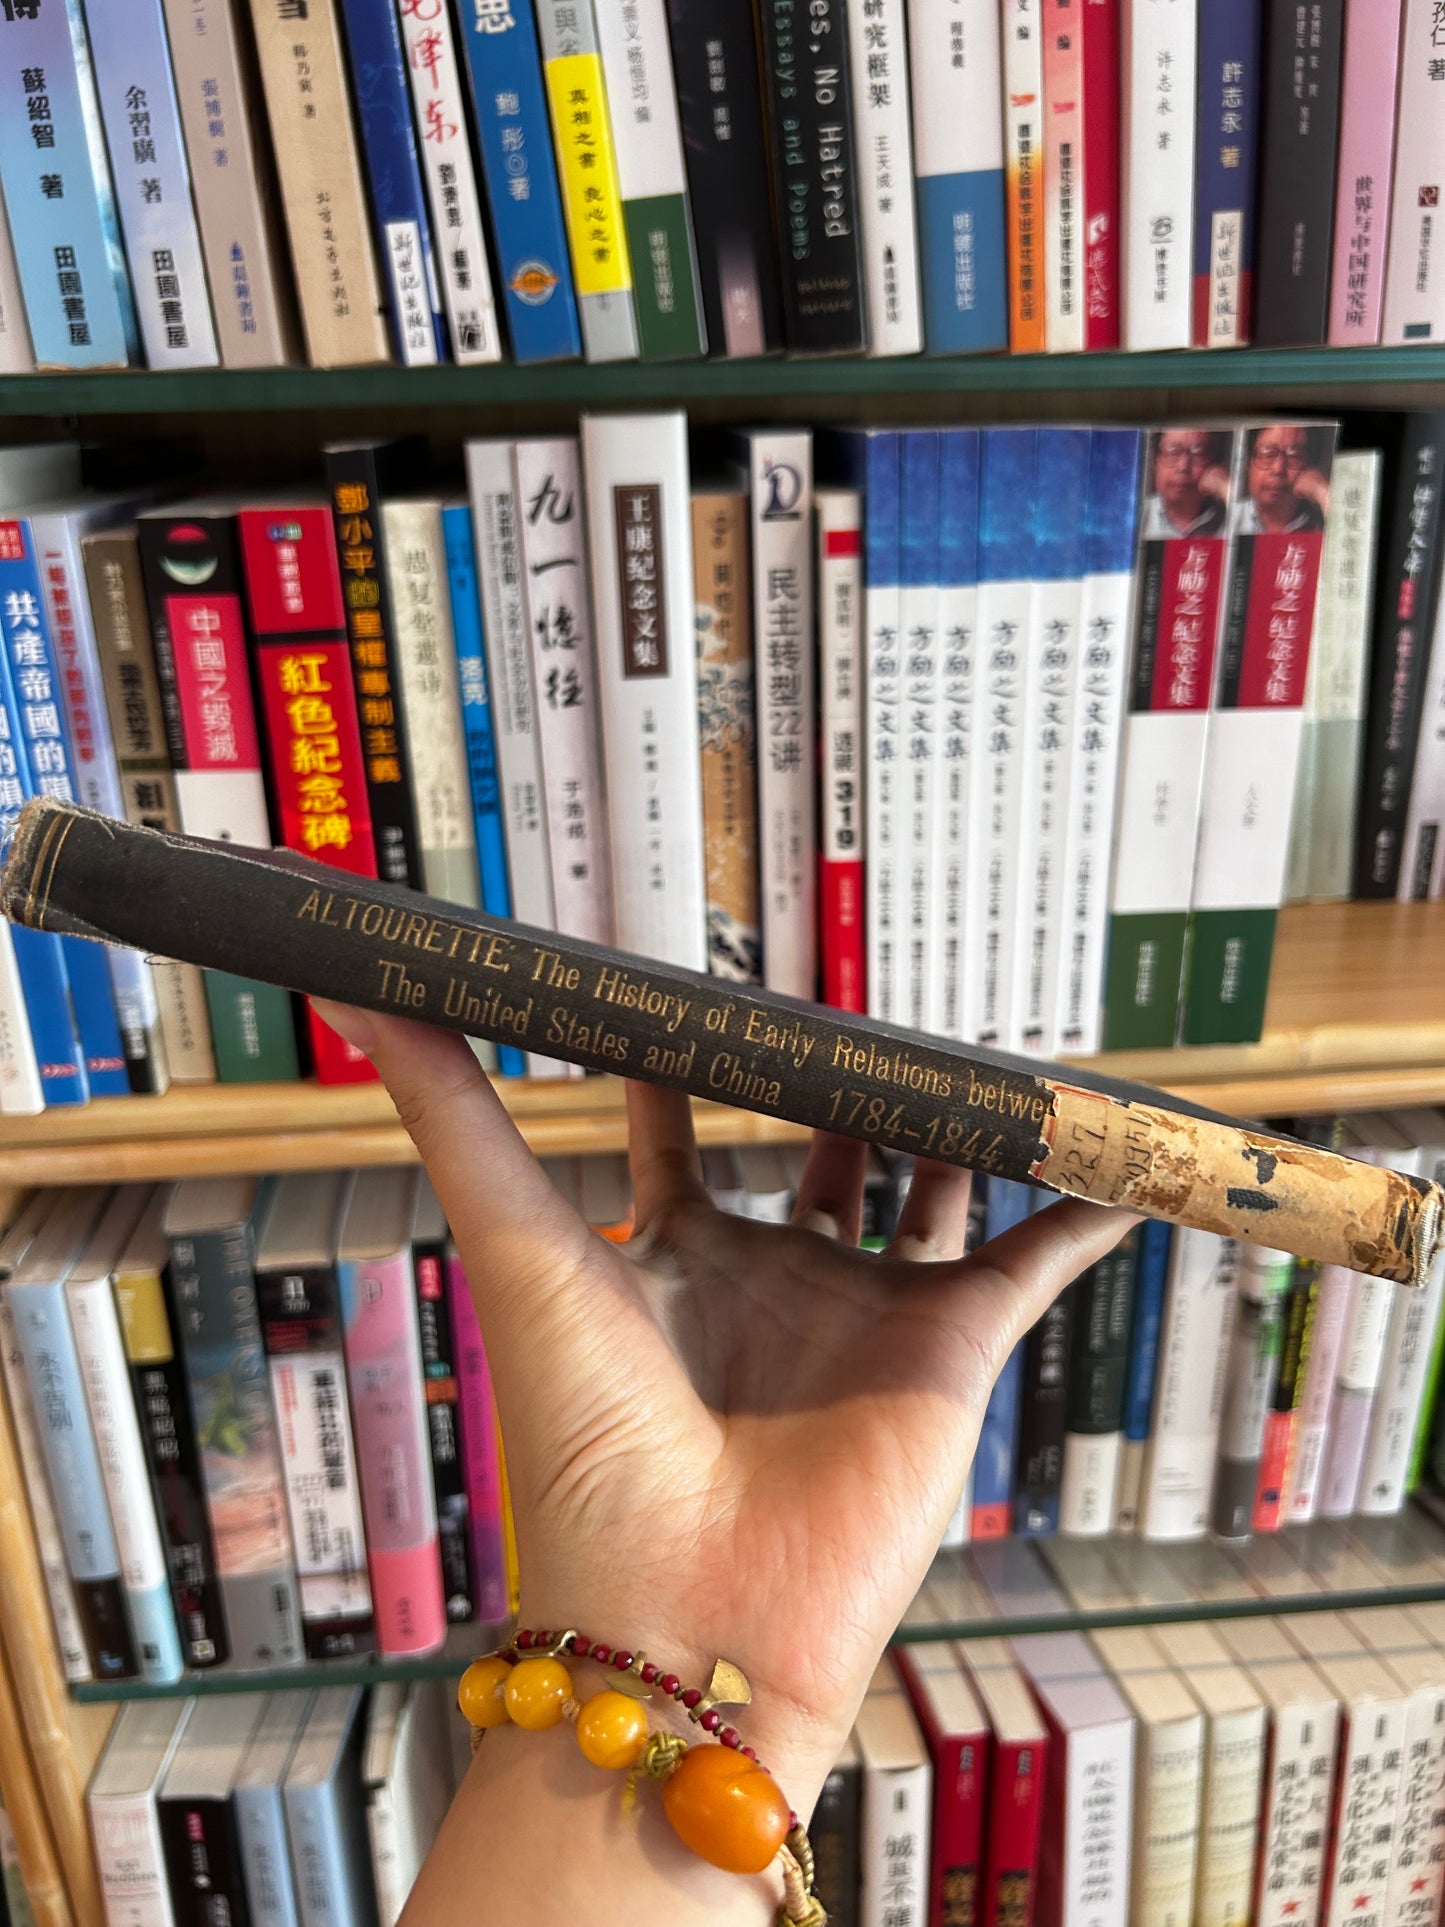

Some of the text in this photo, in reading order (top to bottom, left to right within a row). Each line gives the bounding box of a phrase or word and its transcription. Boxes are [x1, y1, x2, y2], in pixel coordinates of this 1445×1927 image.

[774, 0, 797, 98] Essays
[813, 66, 840, 105] No
[22, 67, 65, 200] 蘇紹智 著
[125, 85, 163, 204] 余習廣 著
[783, 118, 807, 165] and
[1220, 61, 1244, 168] 許志永 著
[817, 126, 852, 238] Hatred
[54, 246, 92, 347] 田園書屋
[152, 249, 189, 349] 田園書屋
[1345, 175, 1373, 328] 世界与中国研究所
[278, 653, 353, 850] 紅色紀念碑
[377, 959, 428, 1009] The
[443, 977, 534, 1036] United
[545, 1006, 632, 1061] States
[643, 1040, 696, 1079] and
[708, 1051, 783, 1107] China
[530, 946, 582, 990] The
[594, 966, 692, 1033] History
[705, 1001, 737, 1035] of
[742, 1008, 816, 1068] Early
[830, 1034, 954, 1098] Relations
